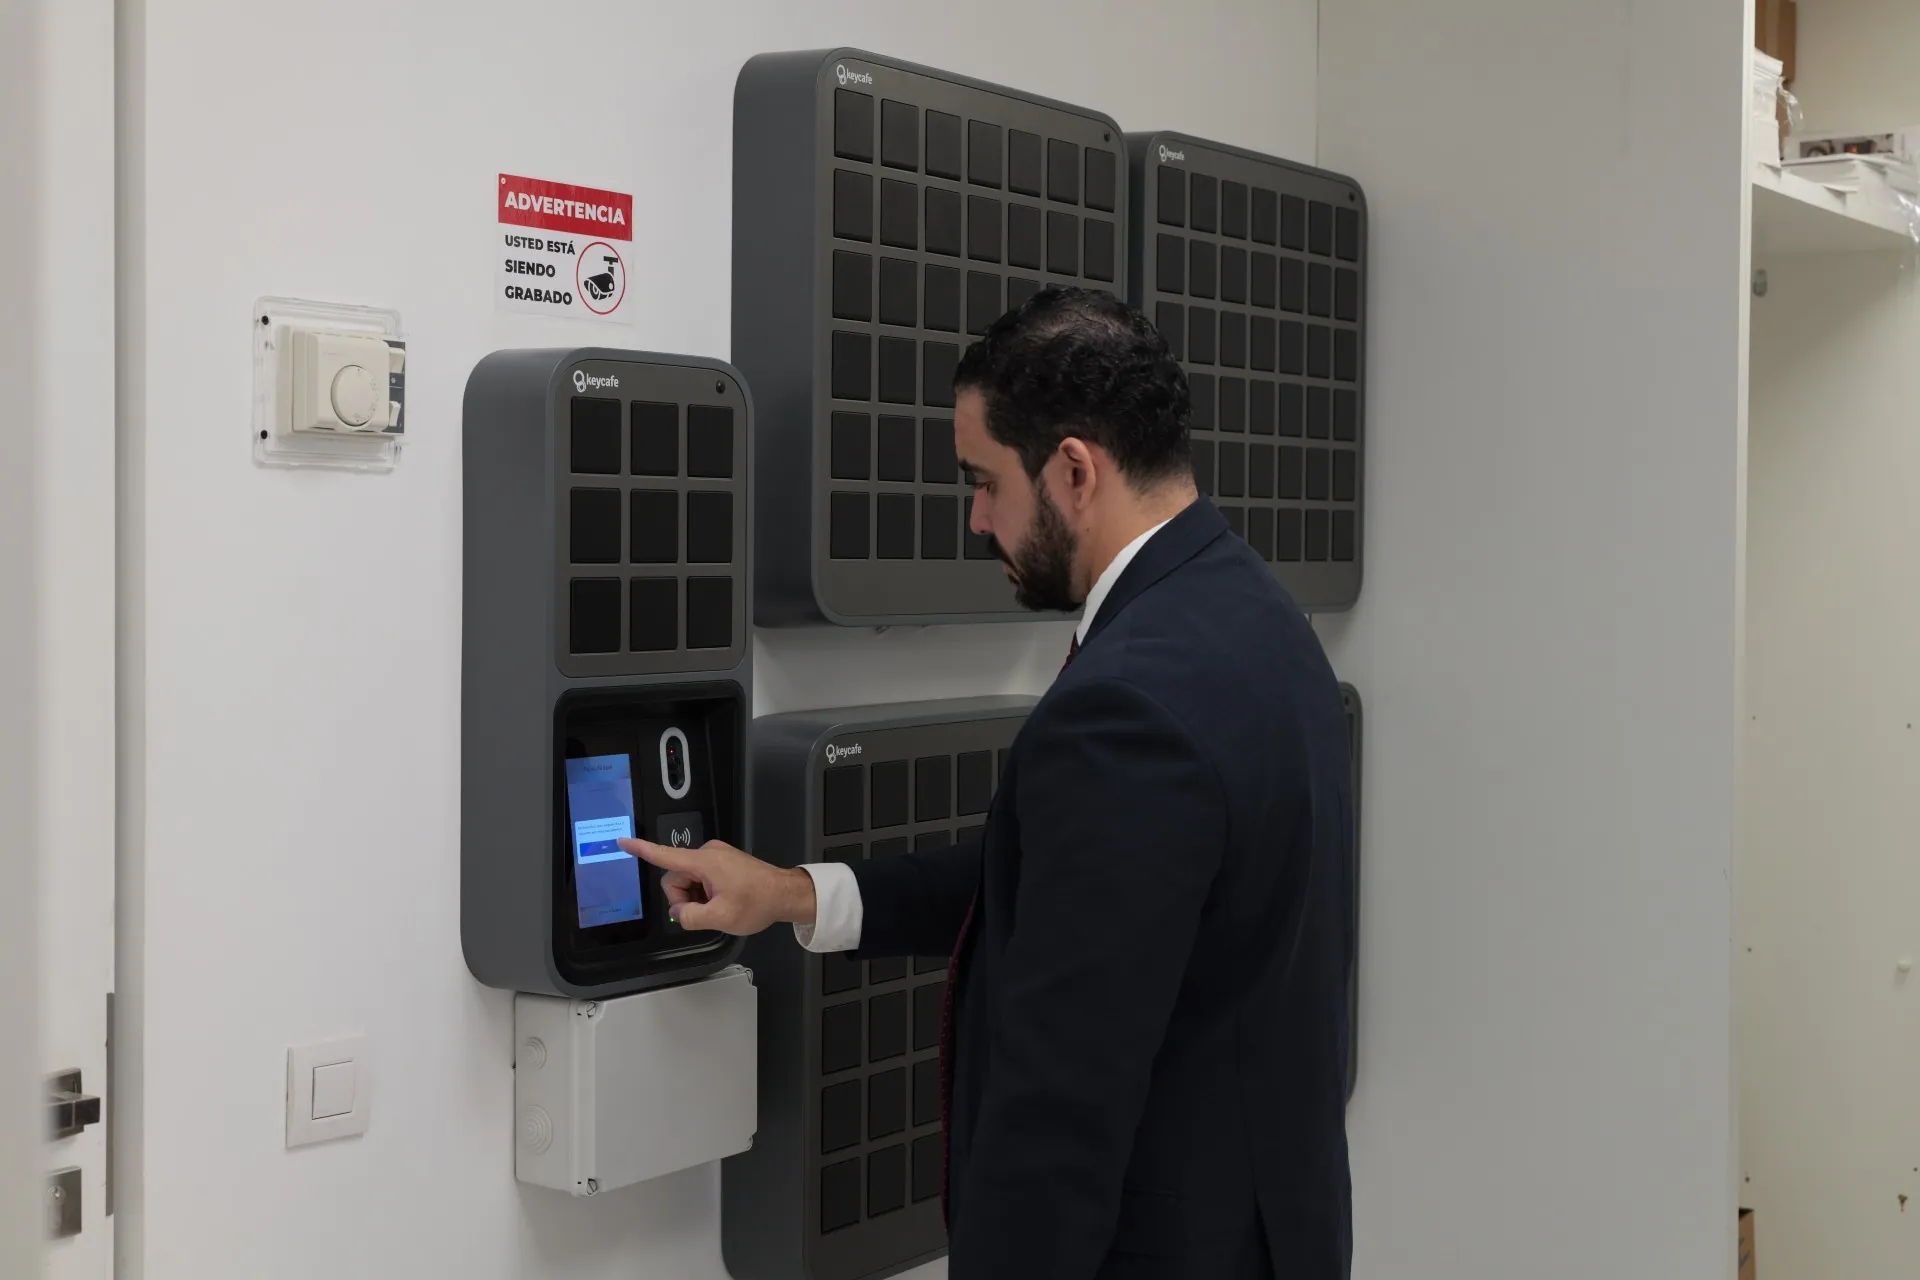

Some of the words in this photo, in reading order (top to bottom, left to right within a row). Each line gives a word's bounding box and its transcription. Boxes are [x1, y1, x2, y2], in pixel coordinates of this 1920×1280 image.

[846, 67, 873, 85] keycafe
[504, 191, 626, 226] ADVERTENCIA
[504, 234, 544, 251] USTED
[547, 240, 576, 255] ESTÁ
[504, 259, 556, 278] SIENDO
[504, 285, 573, 305] GRABADO
[586, 372, 619, 389] keycafe
[835, 743, 862, 758] keycafe
